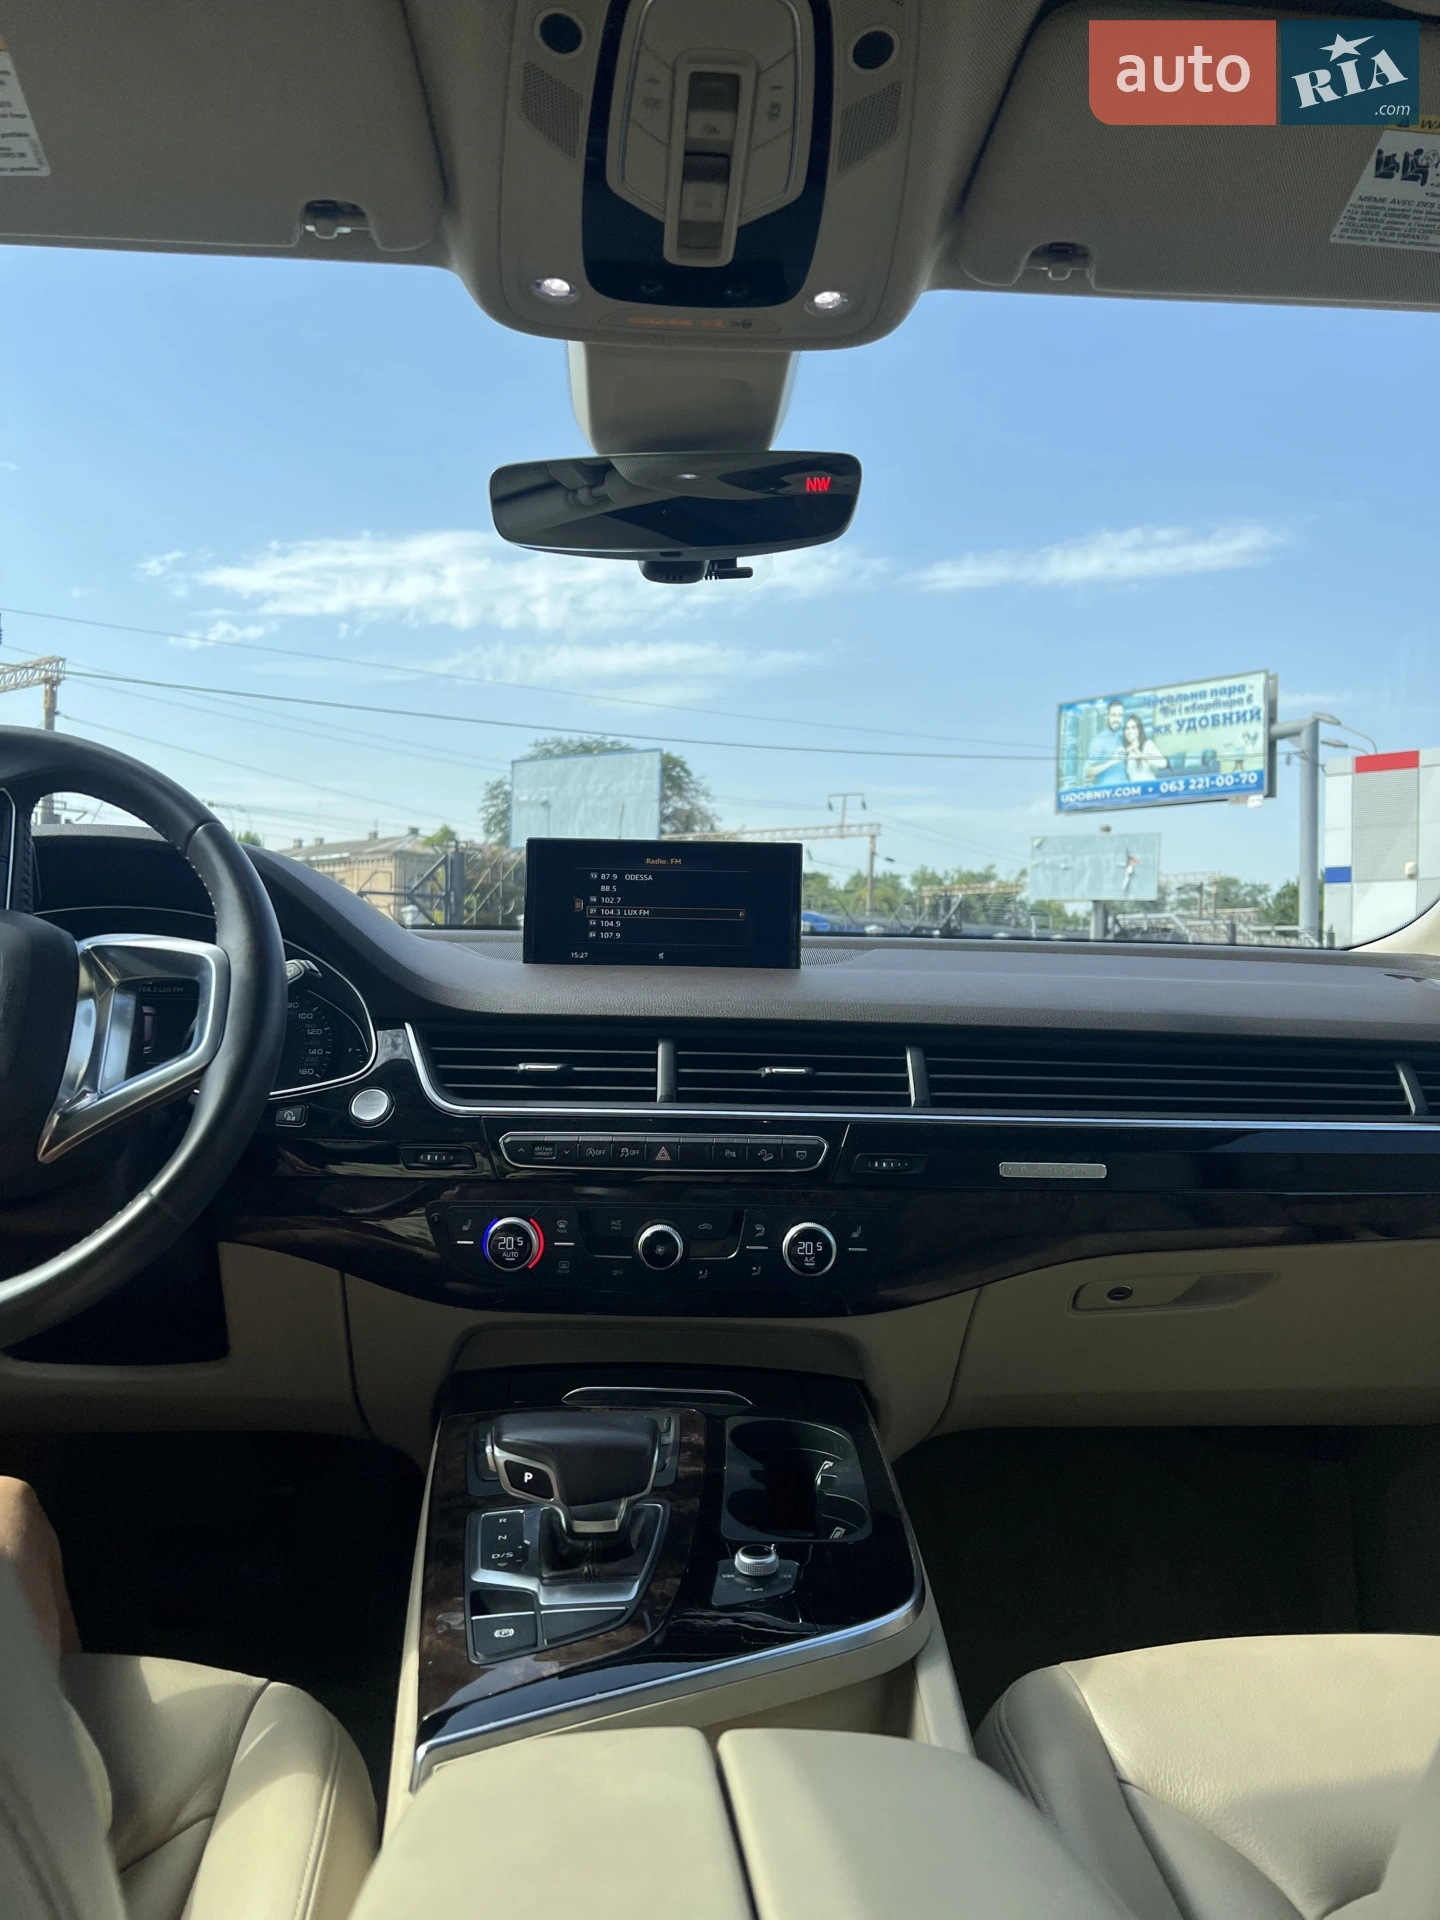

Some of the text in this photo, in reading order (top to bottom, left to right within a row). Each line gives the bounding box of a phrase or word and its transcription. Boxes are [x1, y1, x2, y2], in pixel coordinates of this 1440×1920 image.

[1416, 201, 1436, 209] DES
[807, 476, 831, 491] NW
[1210, 684, 1246, 698] пара
[1176, 706, 1262, 734] УДОБНИЙ
[1159, 771, 1258, 794] 063 221-00-70
[1060, 786, 1142, 804] UDOBNIY.COM
[645, 857, 669, 865] Radio:
[600, 873, 618, 881] 87.9
[600, 908, 621, 916] 104.3
[600, 920, 622, 928] 104.9
[571, 951, 589, 959] 15:27
[298, 1012, 314, 1020] 100
[298, 1067, 314, 1075] 160
[594, 1148, 607, 1156] OFF
[629, 1148, 641, 1156] OFF
[502, 1251, 519, 1259] AUTO
[524, 1471, 534, 1483] P
